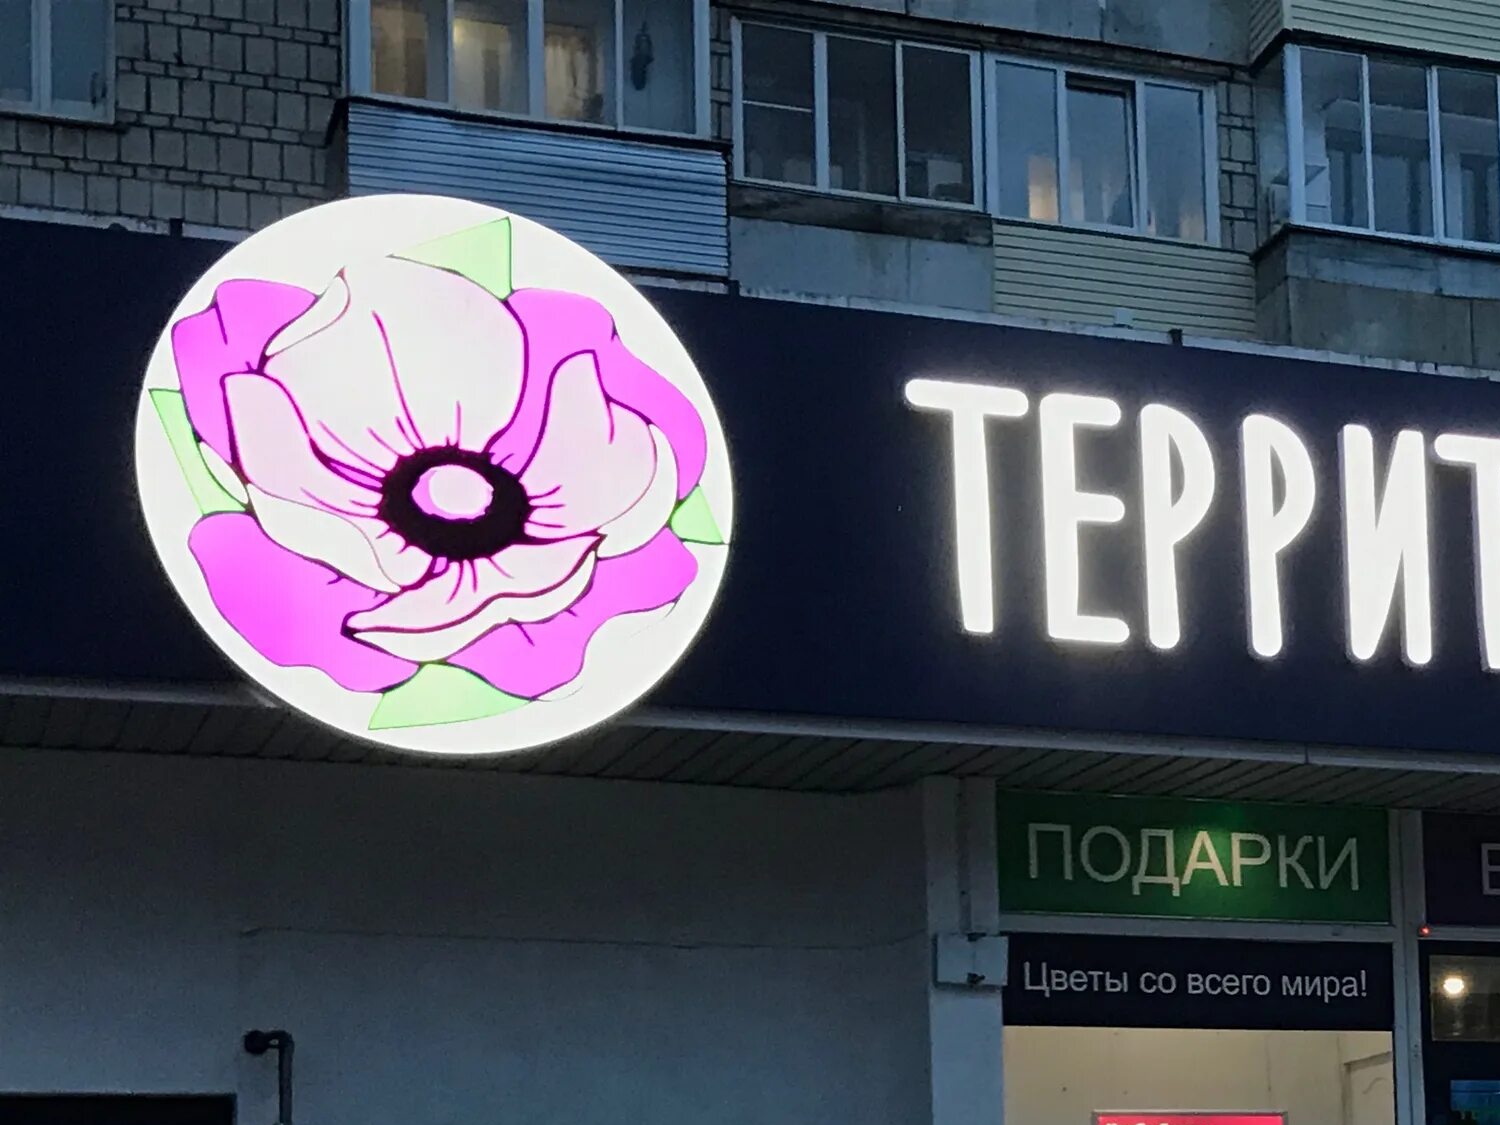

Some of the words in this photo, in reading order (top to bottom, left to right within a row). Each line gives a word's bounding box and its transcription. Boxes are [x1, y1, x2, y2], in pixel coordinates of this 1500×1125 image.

[1027, 822, 1360, 897] ПОДАРКИ
[1023, 961, 1129, 998] Цветы
[1139, 971, 1177, 994] со
[1187, 972, 1272, 996] всего
[1282, 969, 1368, 1003] мира!
